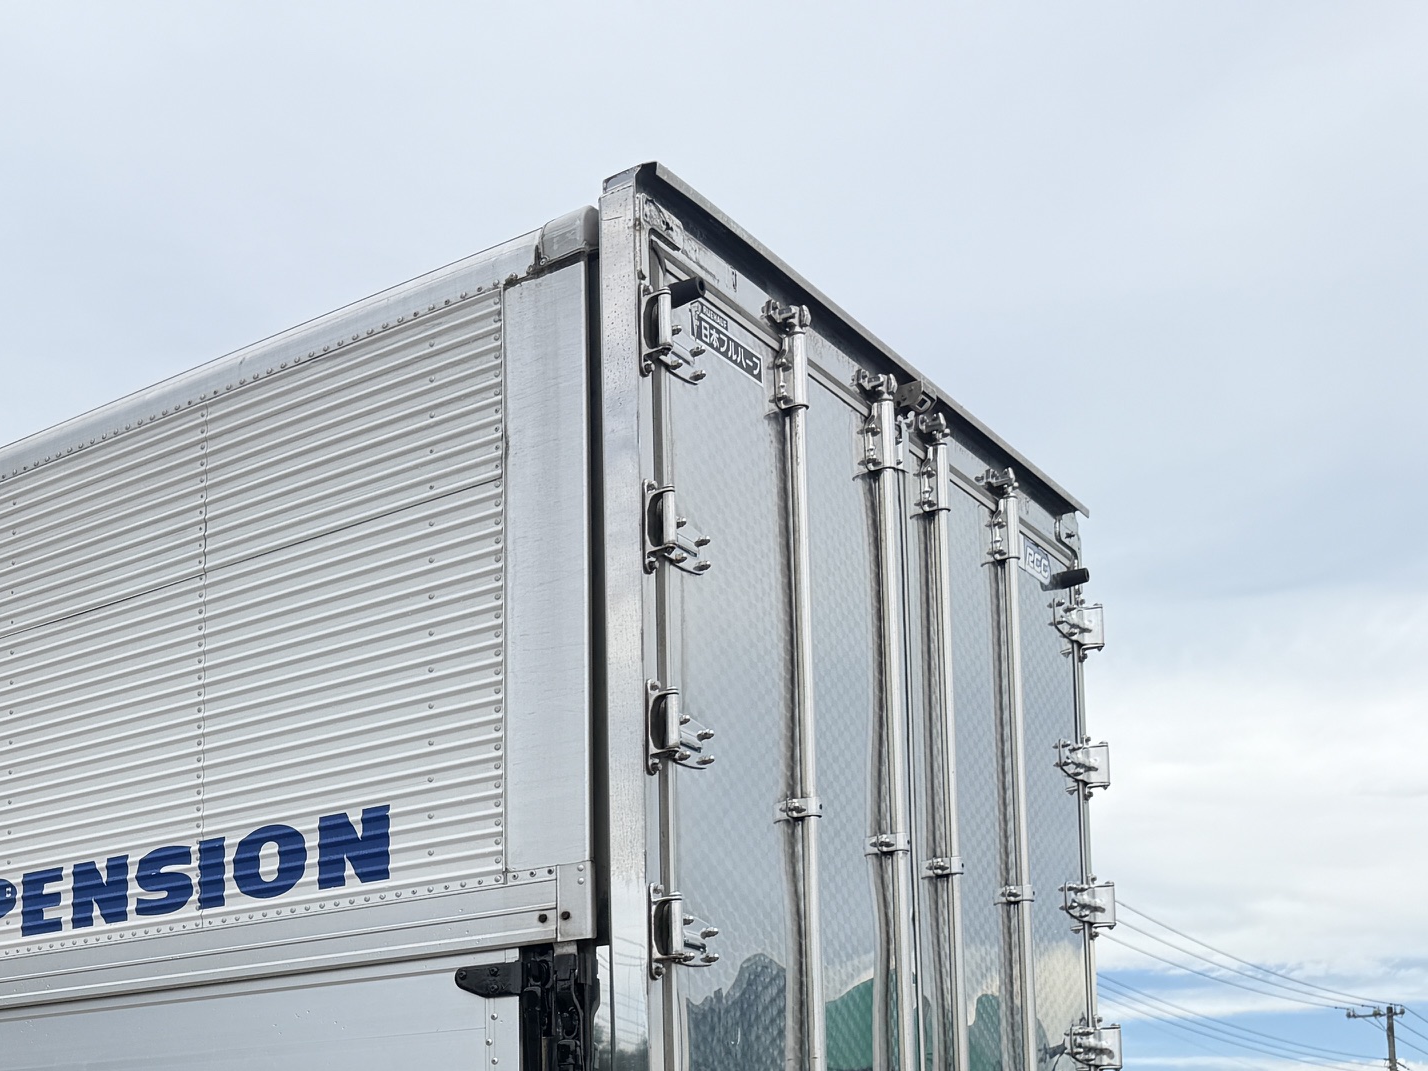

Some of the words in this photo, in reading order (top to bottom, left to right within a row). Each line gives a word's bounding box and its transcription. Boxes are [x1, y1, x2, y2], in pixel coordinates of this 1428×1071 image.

[701, 321, 760, 375] 日本フルハーフ
